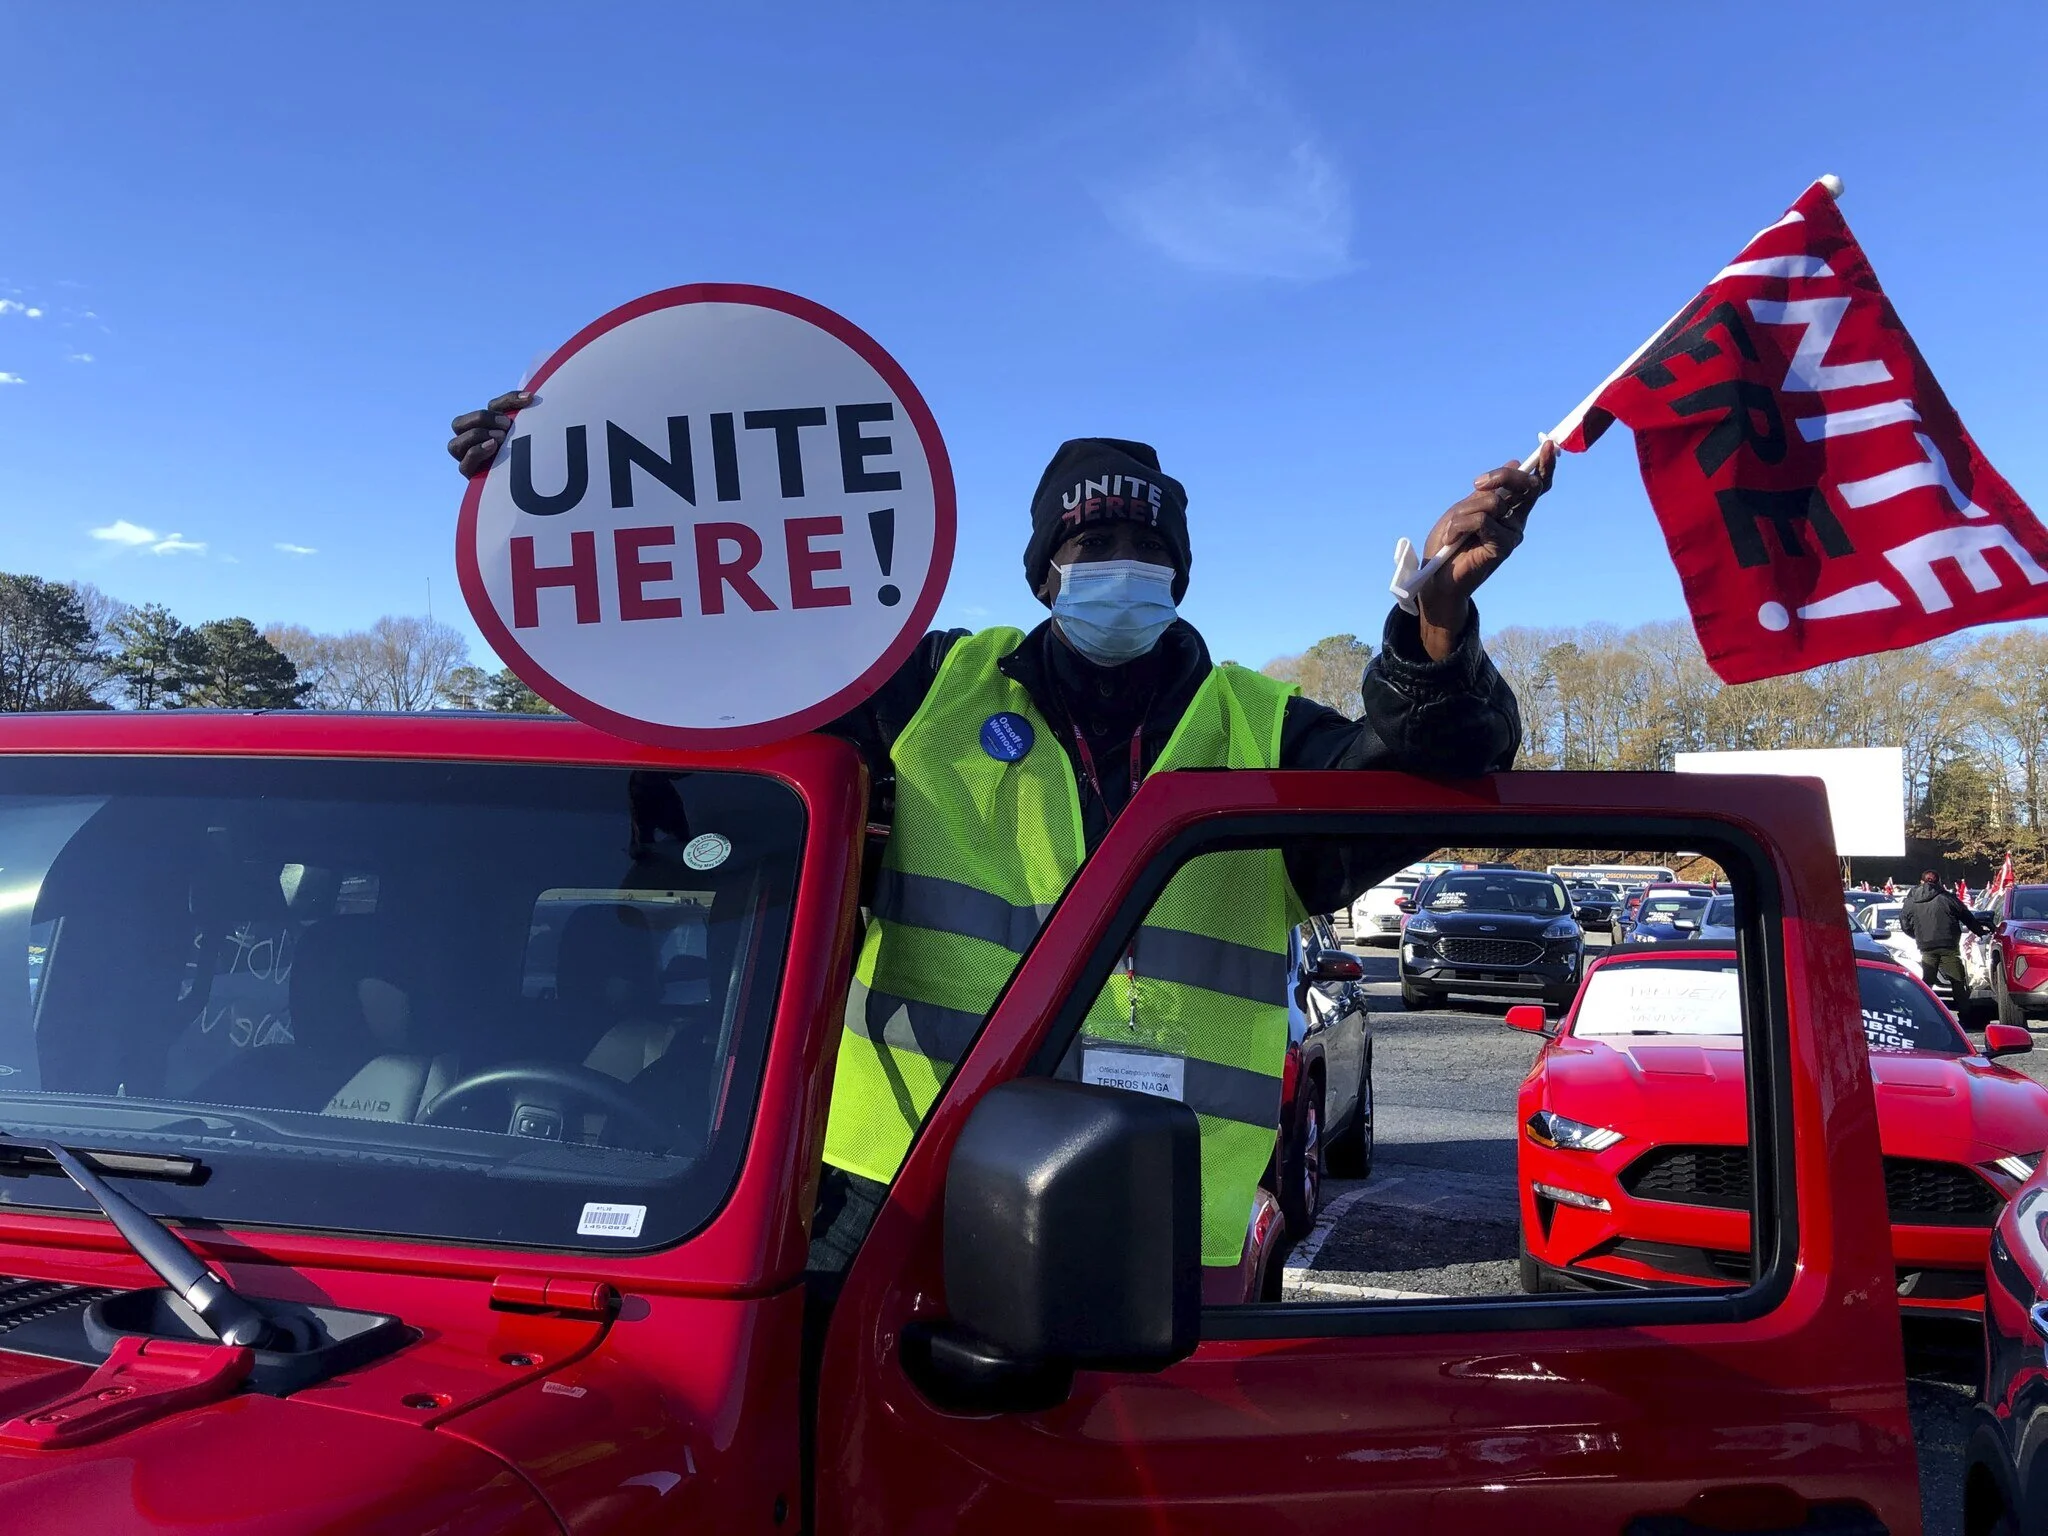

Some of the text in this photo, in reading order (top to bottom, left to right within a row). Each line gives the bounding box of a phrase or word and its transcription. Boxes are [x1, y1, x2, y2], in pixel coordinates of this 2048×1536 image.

[510, 402, 902, 516] UNITE
[1062, 475, 1163, 510] UNITE
[510, 508, 902, 629] HERE!
[989, 719, 1018, 757] Warnock
[999, 716, 1024, 749] Ossoff &
[1096, 1077, 1170, 1093] TEDROS NAGA
[1098, 1065, 1172, 1079] Official Campaign Worker
